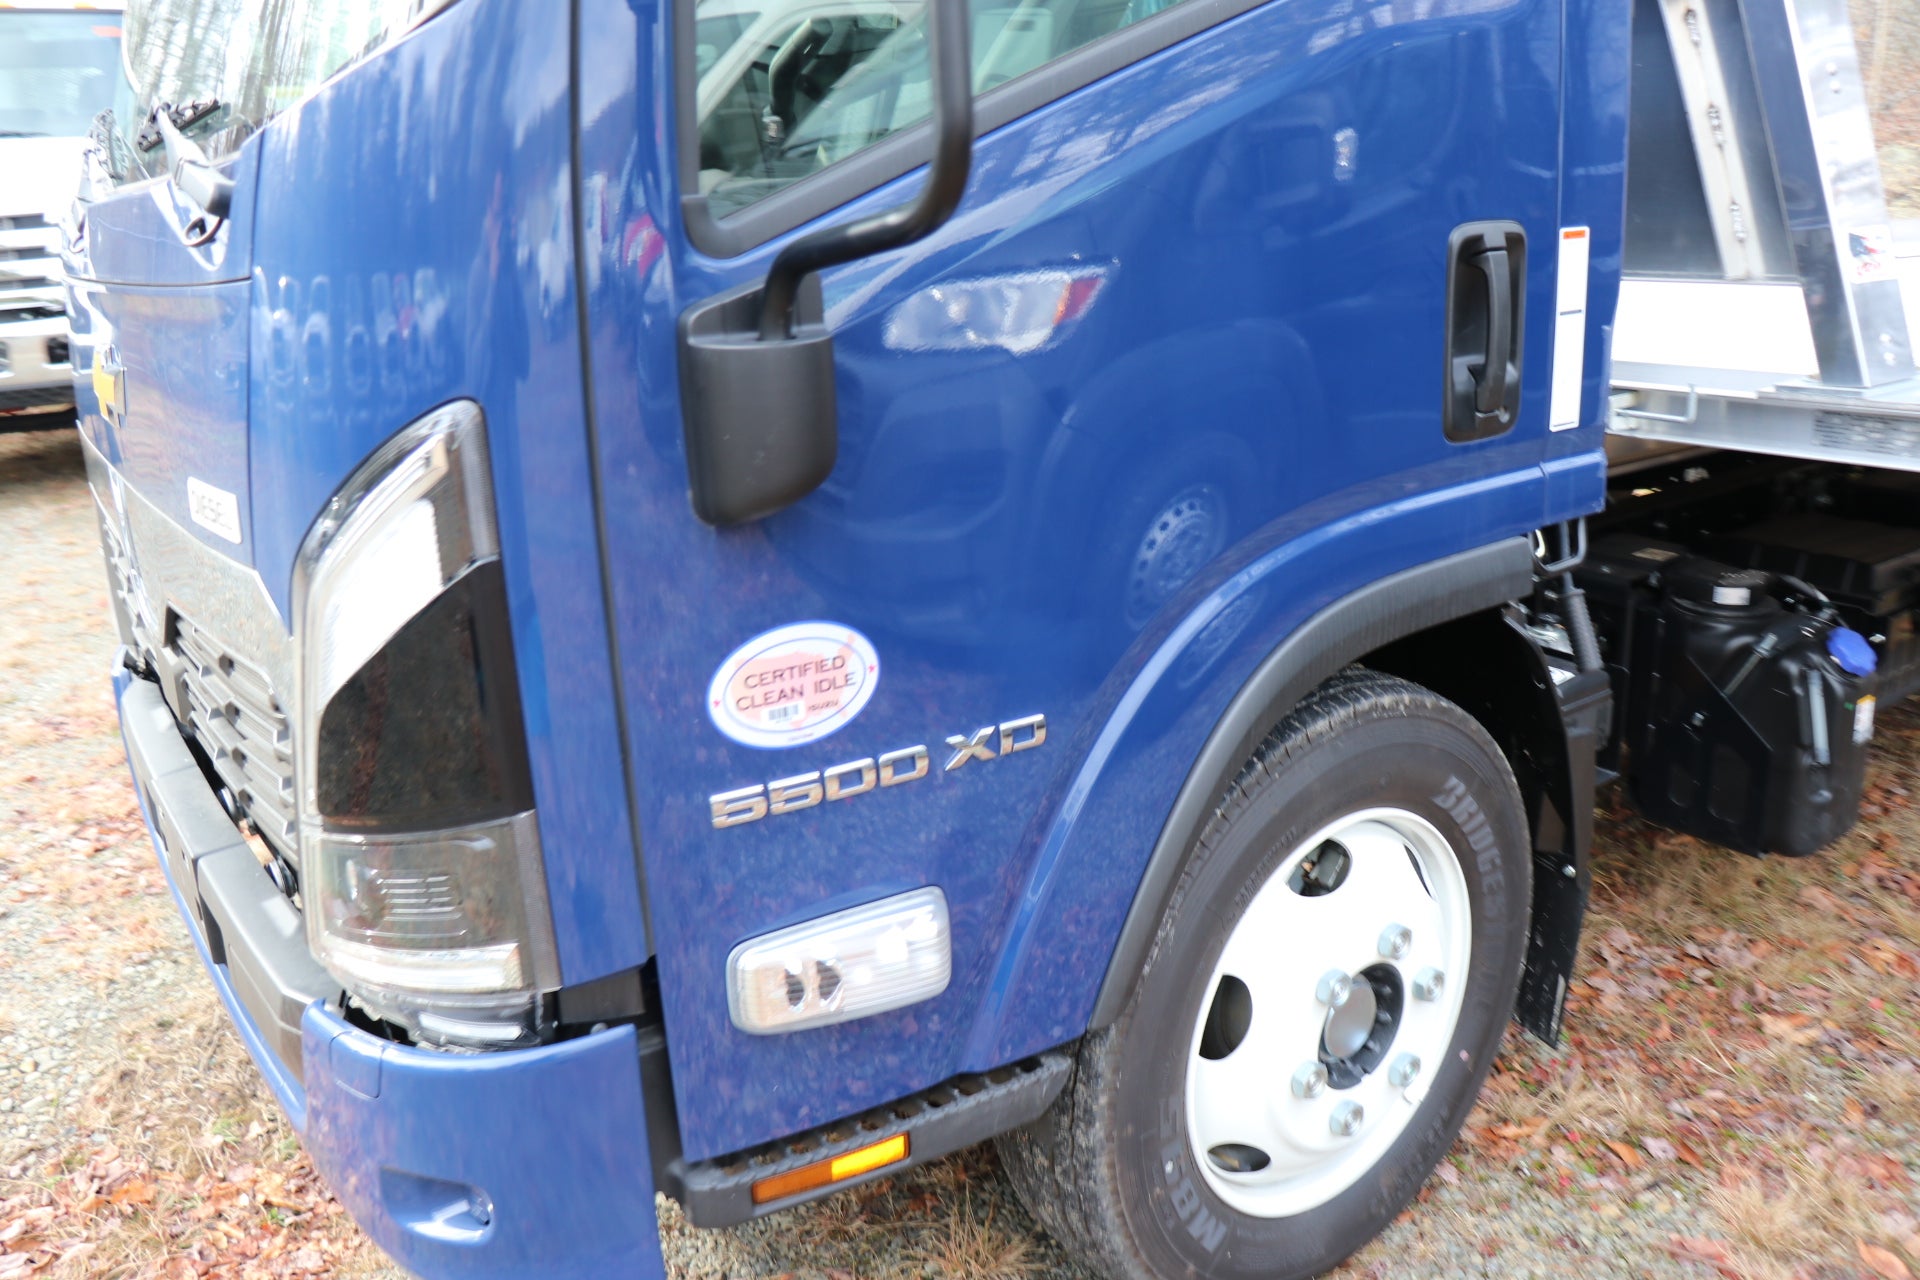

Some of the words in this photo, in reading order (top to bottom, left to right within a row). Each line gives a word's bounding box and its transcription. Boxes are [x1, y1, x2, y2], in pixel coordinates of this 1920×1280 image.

[735, 684, 804, 711] CLEAN
[813, 671, 857, 694] IDLE
[744, 655, 845, 689] CERTIFIED
[709, 744, 929, 829] 5500
[944, 713, 1047, 771] XD
[1432, 775, 1507, 988] BRIDGEST
[1159, 1094, 1227, 1253] M895
